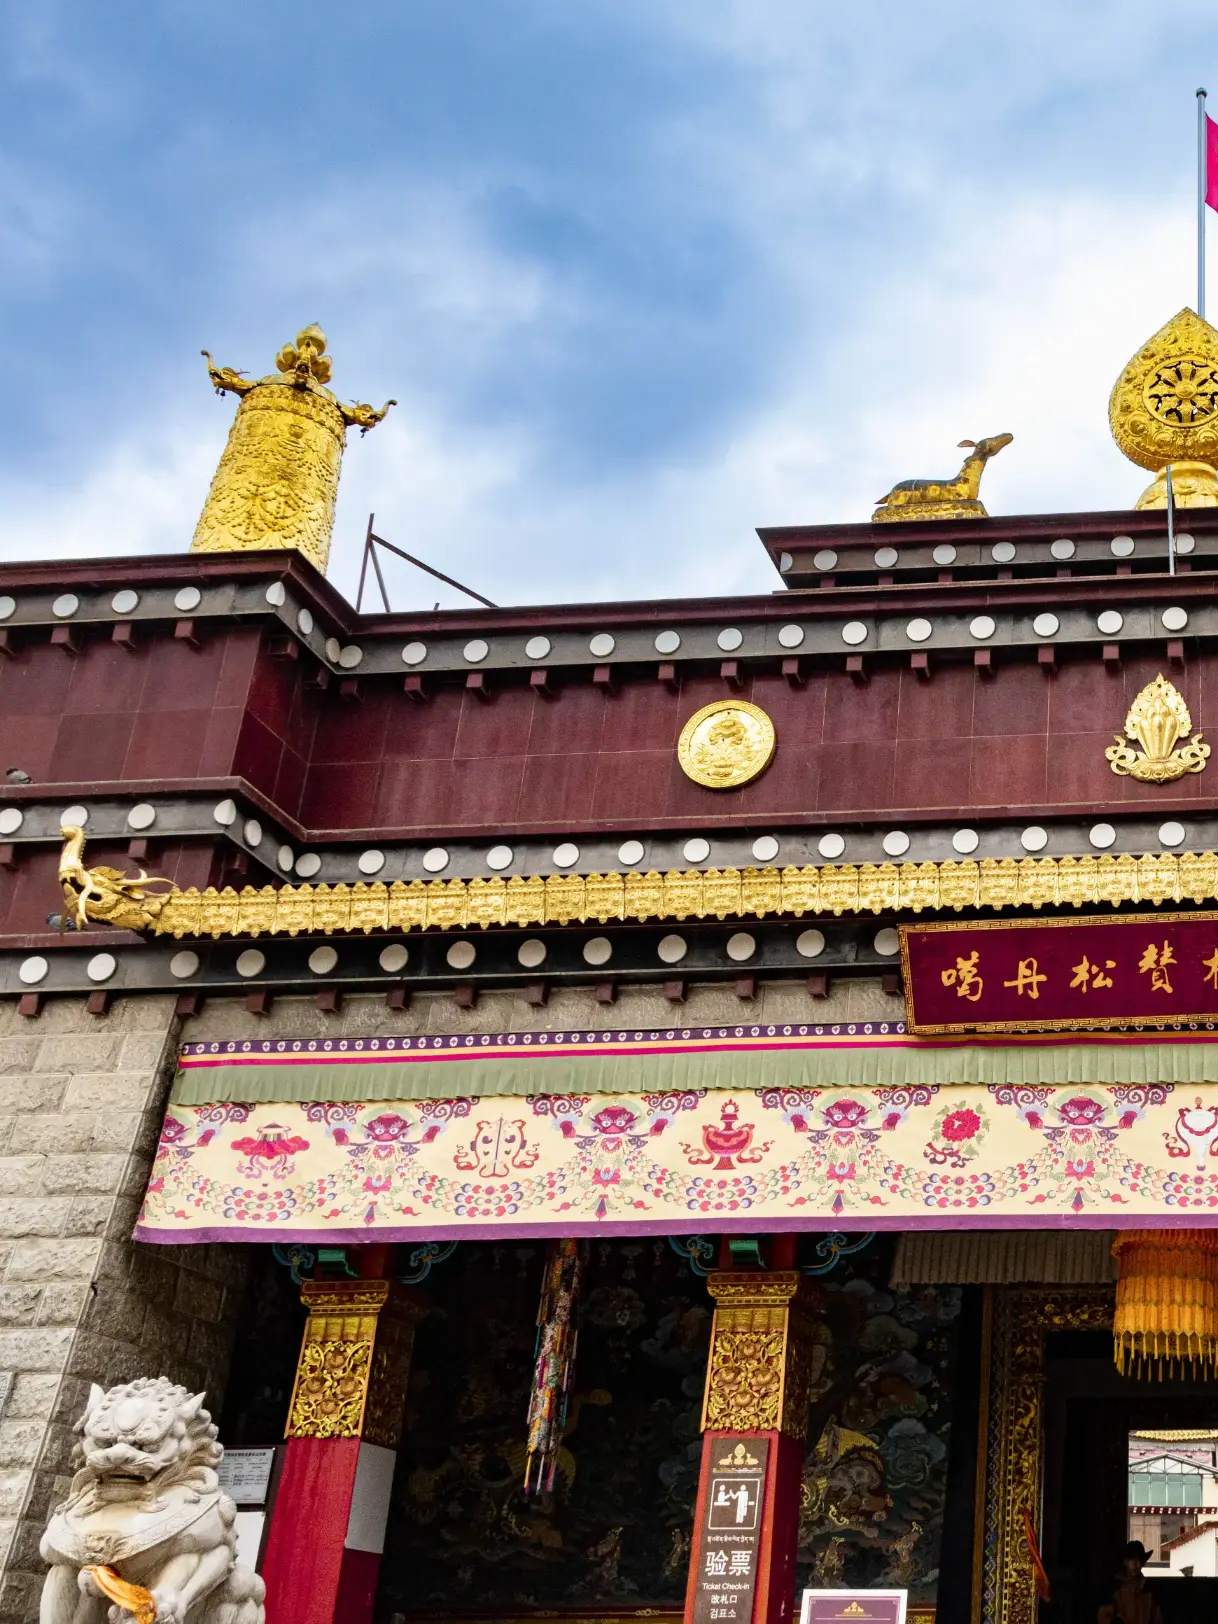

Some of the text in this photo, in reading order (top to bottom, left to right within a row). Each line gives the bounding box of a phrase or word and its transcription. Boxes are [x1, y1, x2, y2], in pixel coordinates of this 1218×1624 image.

[704, 1549, 752, 1577] 验票
[702, 1582, 750, 1590] Ticket Check-in
[710, 1594, 738, 1604] 改札口
[709, 1608, 737, 1619] 검표소
